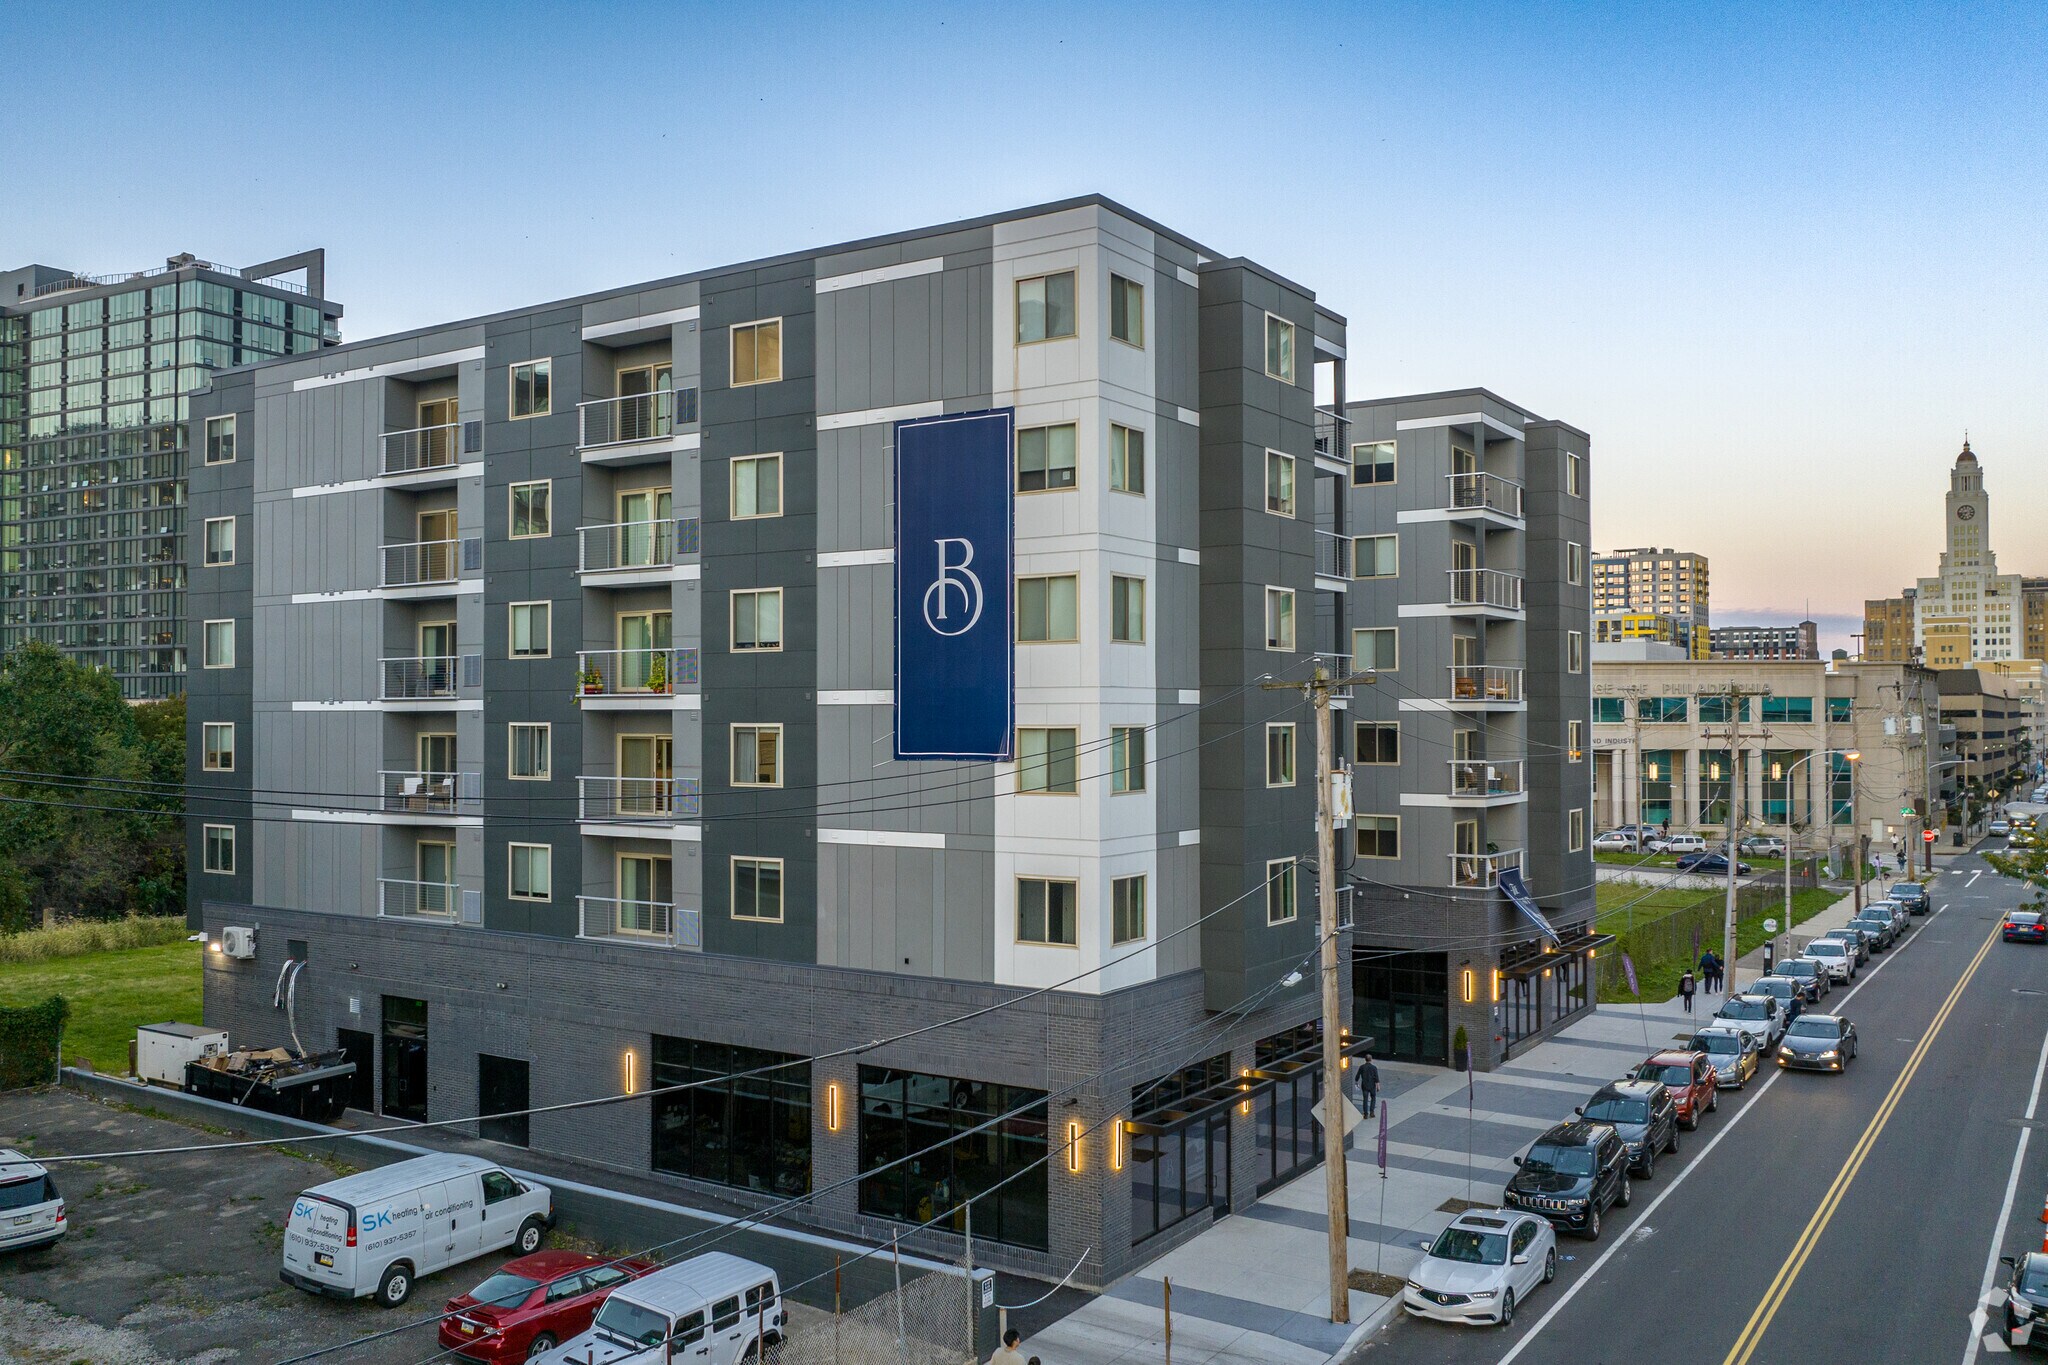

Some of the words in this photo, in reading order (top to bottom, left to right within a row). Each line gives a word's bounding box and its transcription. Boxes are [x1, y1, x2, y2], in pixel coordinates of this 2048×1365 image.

[294, 1203, 314, 1220] SK
[392, 1207, 417, 1221] heating
[420, 1204, 424, 1212] &
[424, 1211, 434, 1220] air
[434, 1200, 473, 1216] conditioning
[320, 1214, 338, 1225] heating
[362, 1210, 392, 1232] SK
[289, 1233, 304, 1245] (610)
[304, 1239, 340, 1254] 937-5357
[314, 1230, 342, 1242] conditioning
[365, 1241, 383, 1252] (610)
[383, 1230, 417, 1246] 937-5357
